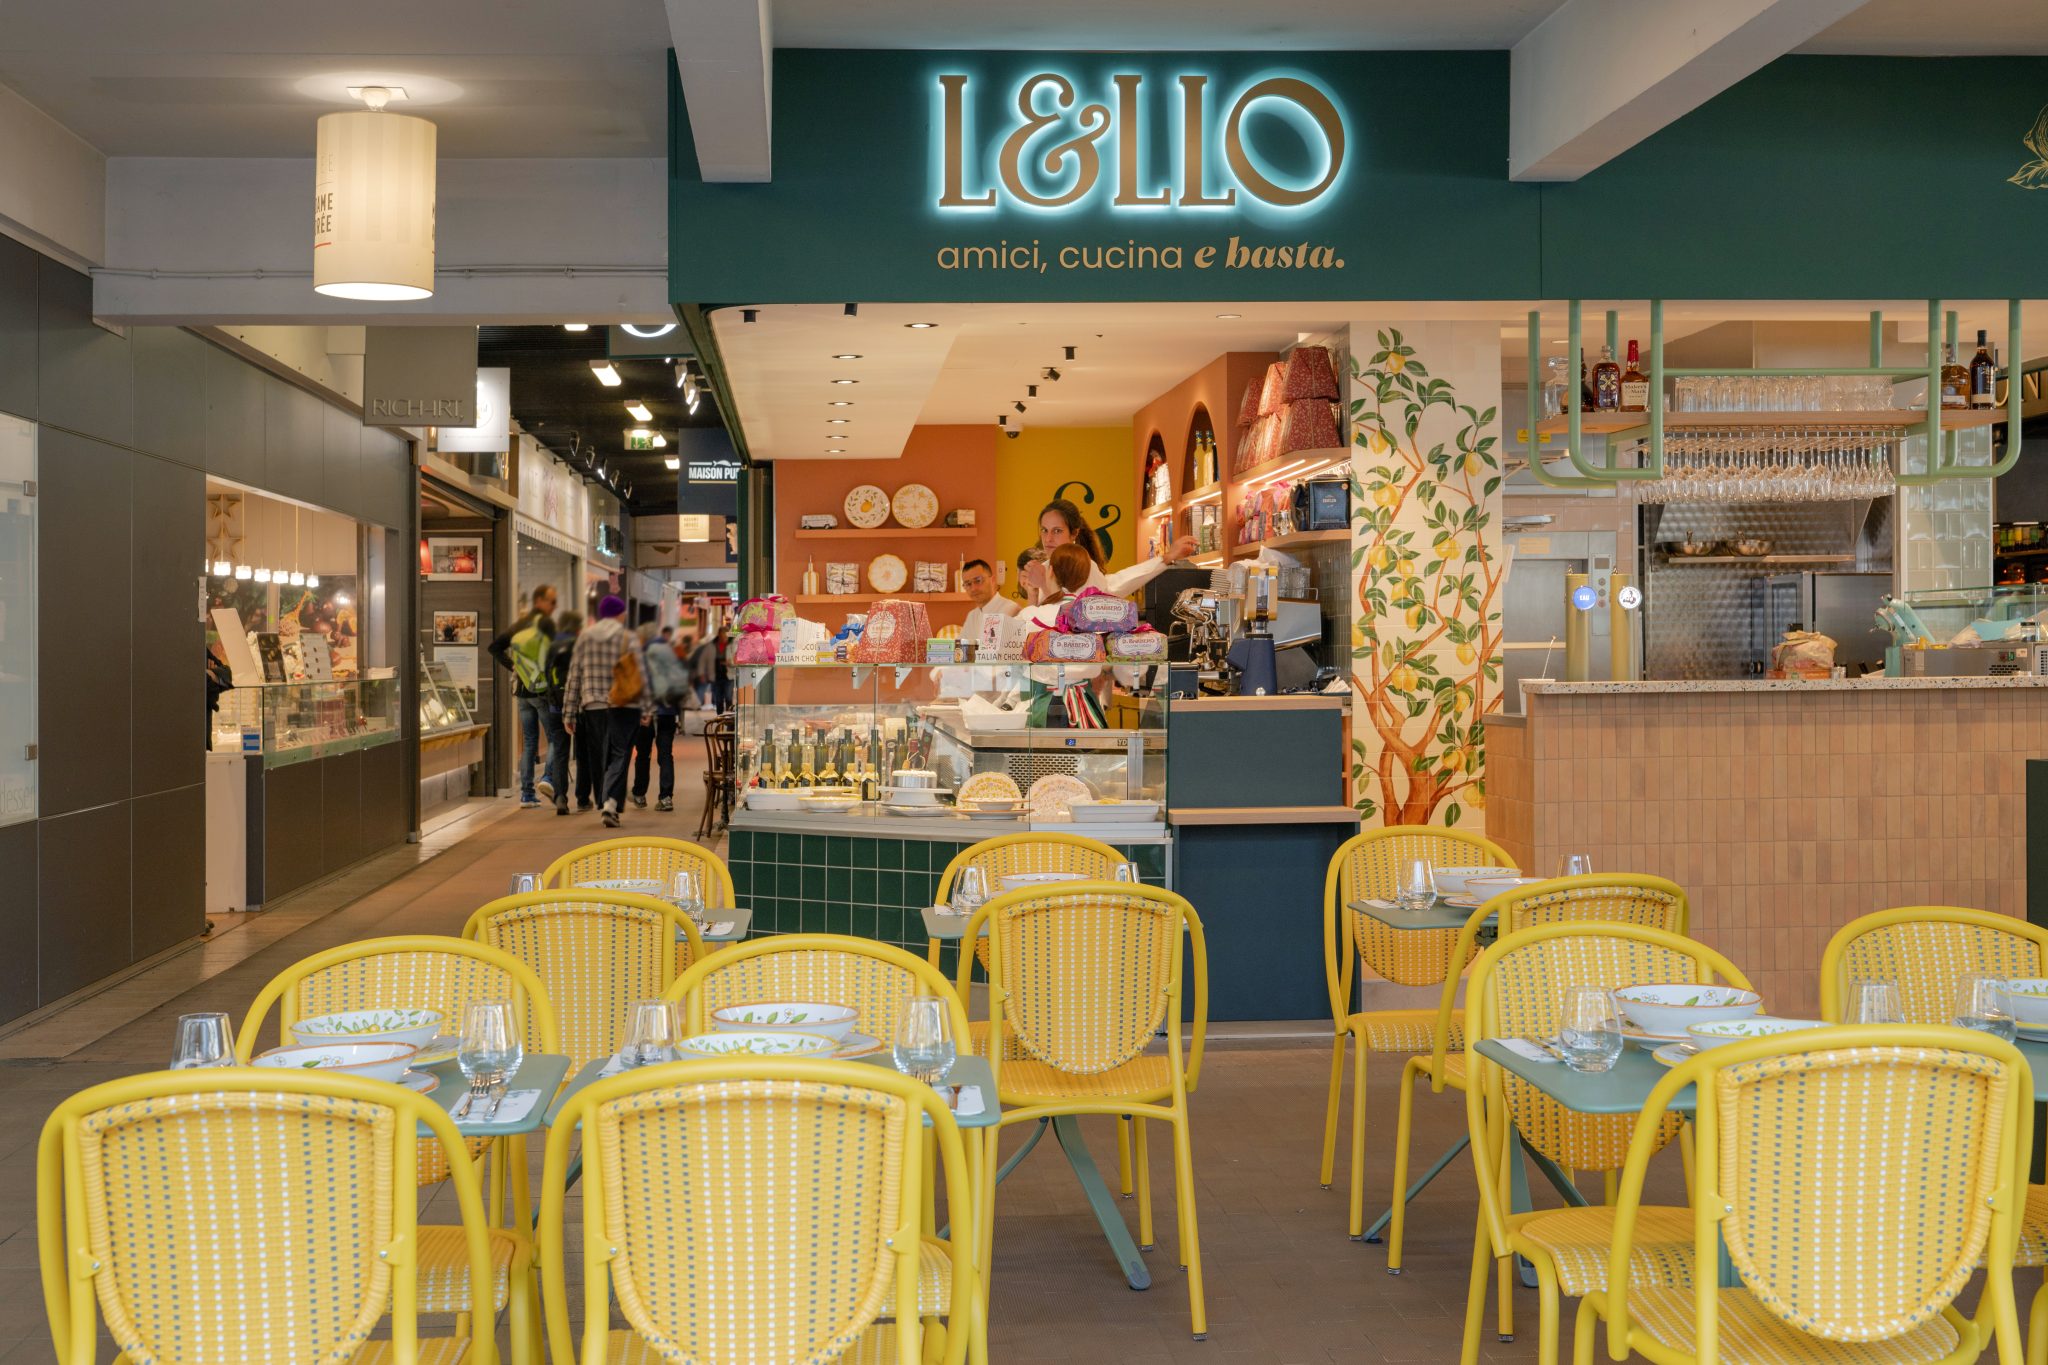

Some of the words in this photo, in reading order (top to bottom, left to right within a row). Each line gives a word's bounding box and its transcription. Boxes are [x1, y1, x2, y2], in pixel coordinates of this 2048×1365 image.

[937, 240, 1047, 275] amici,
[1059, 240, 1182, 269] cucina
[1194, 247, 1215, 269] e
[1225, 236, 1346, 269] basta.
[688, 467, 723, 480] MAISON
